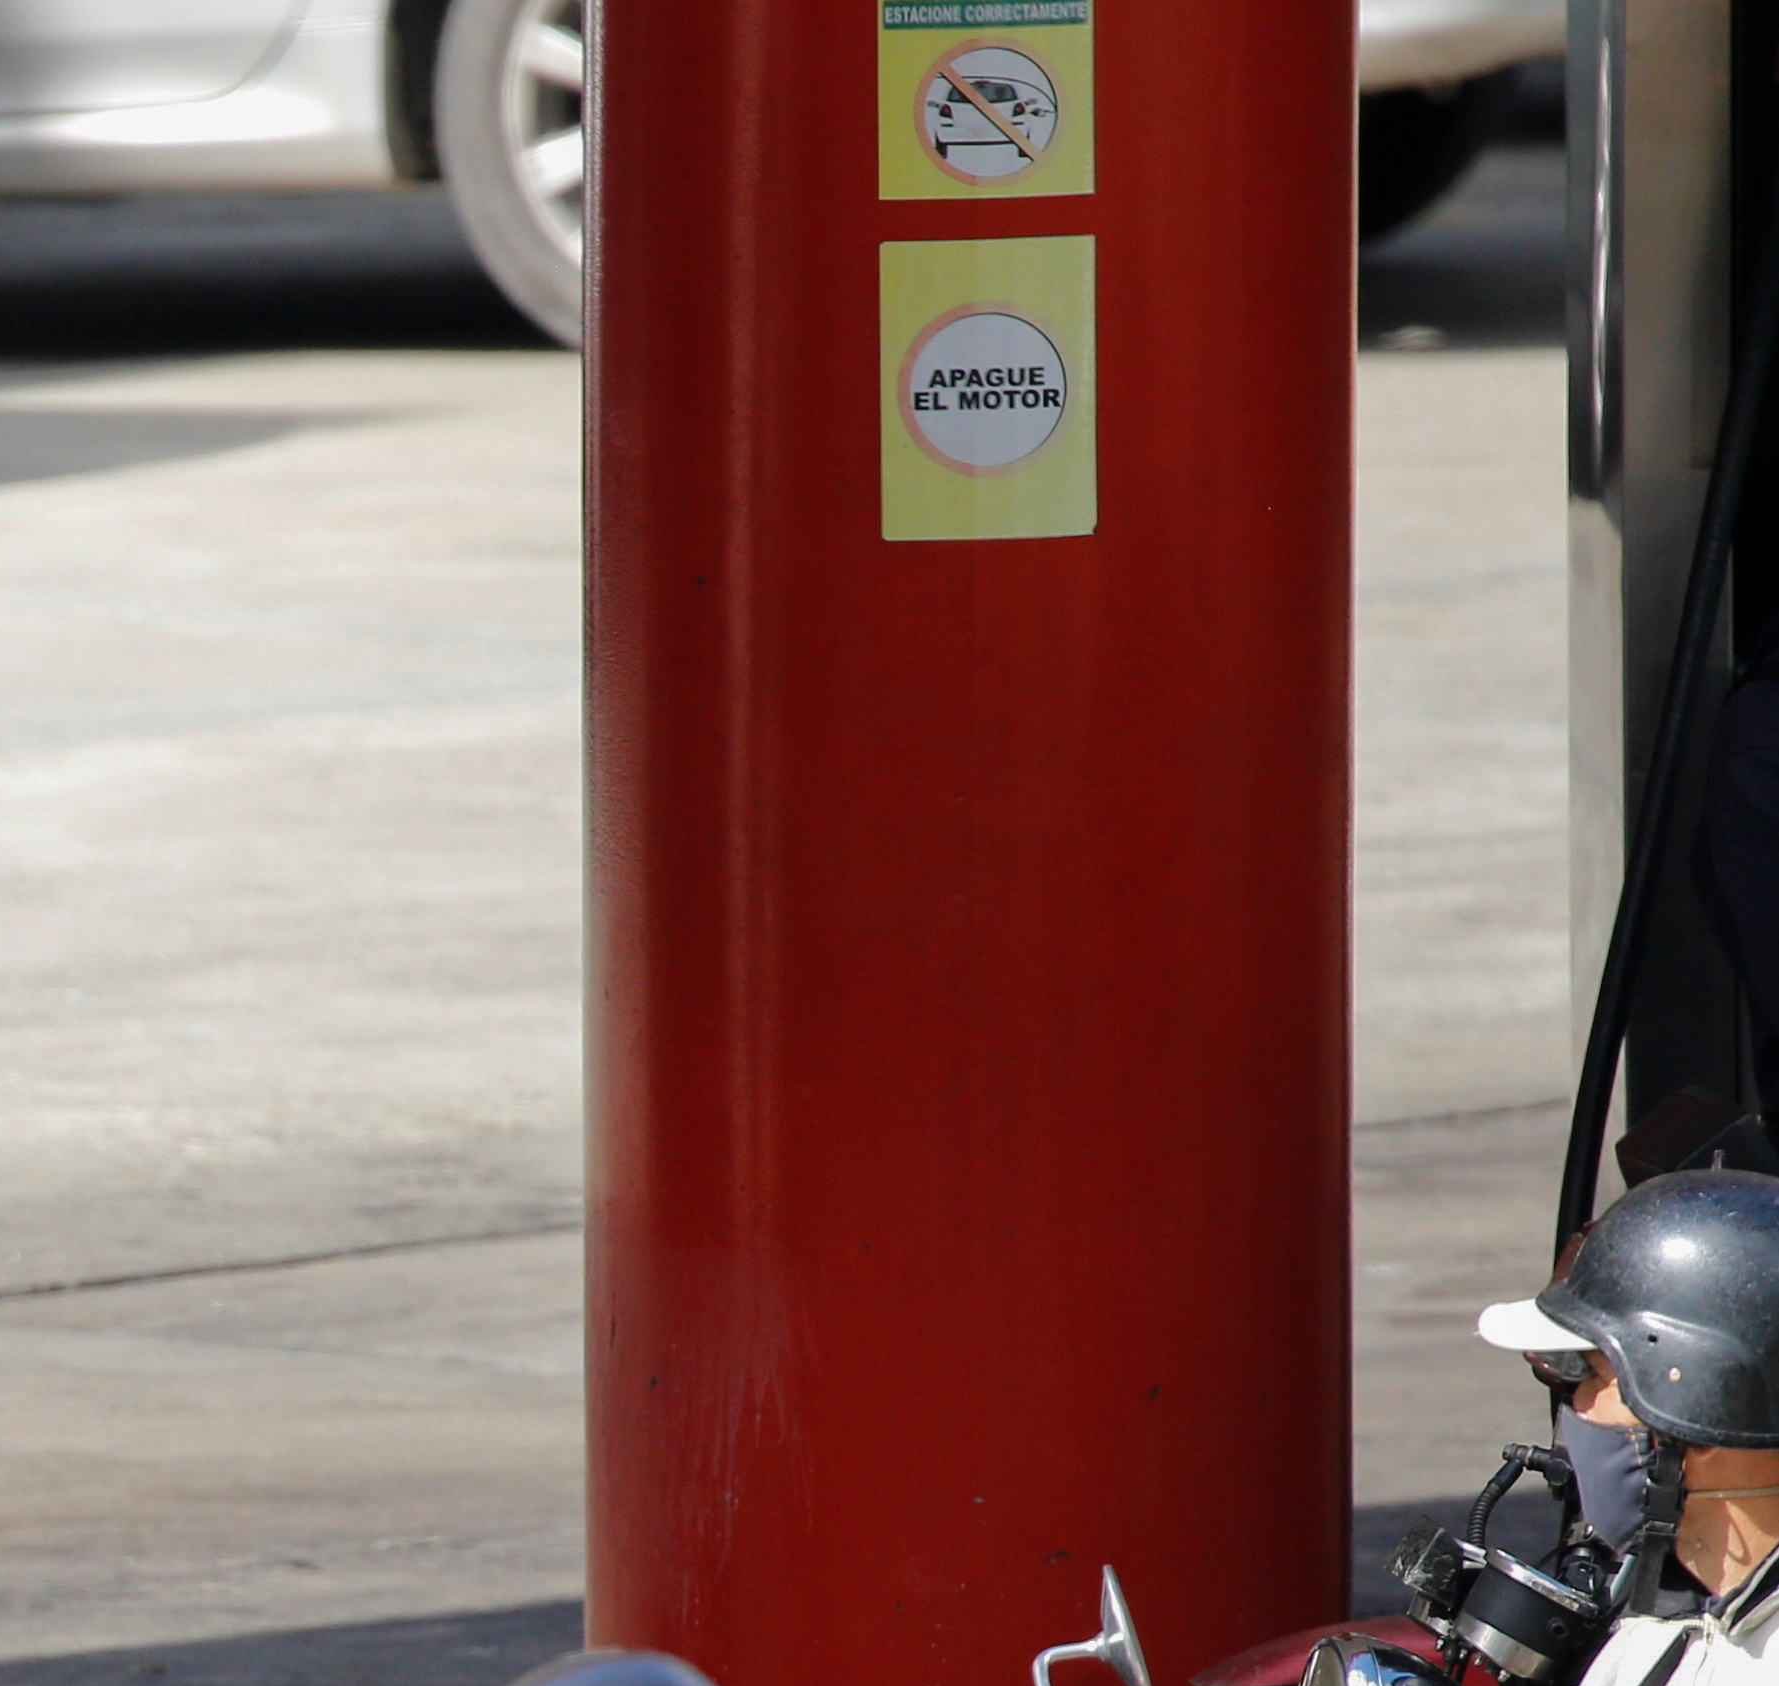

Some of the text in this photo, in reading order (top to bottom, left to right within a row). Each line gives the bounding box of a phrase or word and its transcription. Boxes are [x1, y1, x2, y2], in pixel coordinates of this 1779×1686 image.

[884, 2, 1087, 24] ESTACIONE CORRECTAMENTE
[929, 367, 1045, 388] APAGUE
[914, 388, 1061, 411] EL MOTOR
